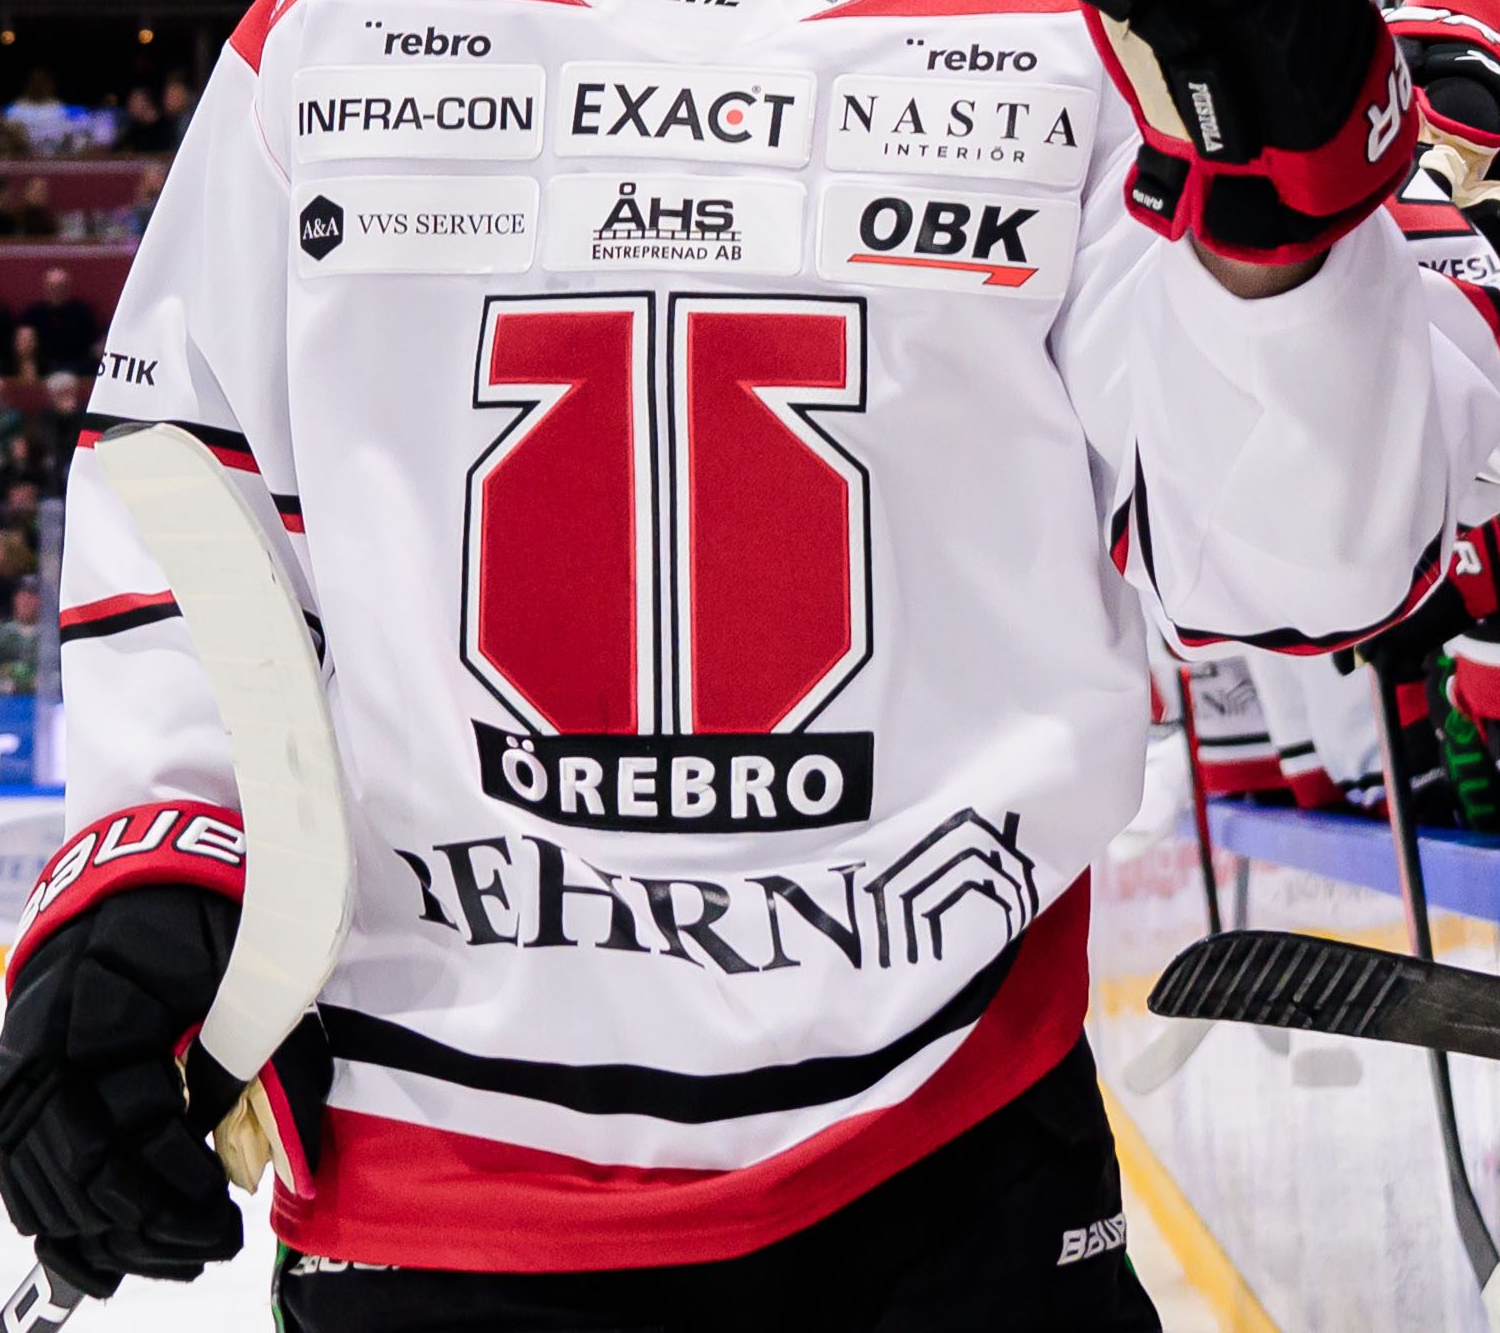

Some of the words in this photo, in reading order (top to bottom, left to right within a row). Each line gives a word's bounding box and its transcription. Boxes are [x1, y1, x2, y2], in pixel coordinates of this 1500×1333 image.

[298, 95, 535, 137] INFRA-CON
[571, 81, 797, 148] EXACT
[838, 94, 1080, 148] NASTA
[883, 142, 1027, 164] INTERIÖR
[302, 217, 339, 238] A&A
[357, 213, 409, 235] VVS
[414, 212, 526, 236] SERVICE
[600, 181, 735, 234] ÅHS
[859, 197, 1040, 264] OBK
[592, 244, 708, 261] ENTREPRENAD
[714, 245, 742, 261] AB
[498, 733, 846, 820] ÖREBRO
